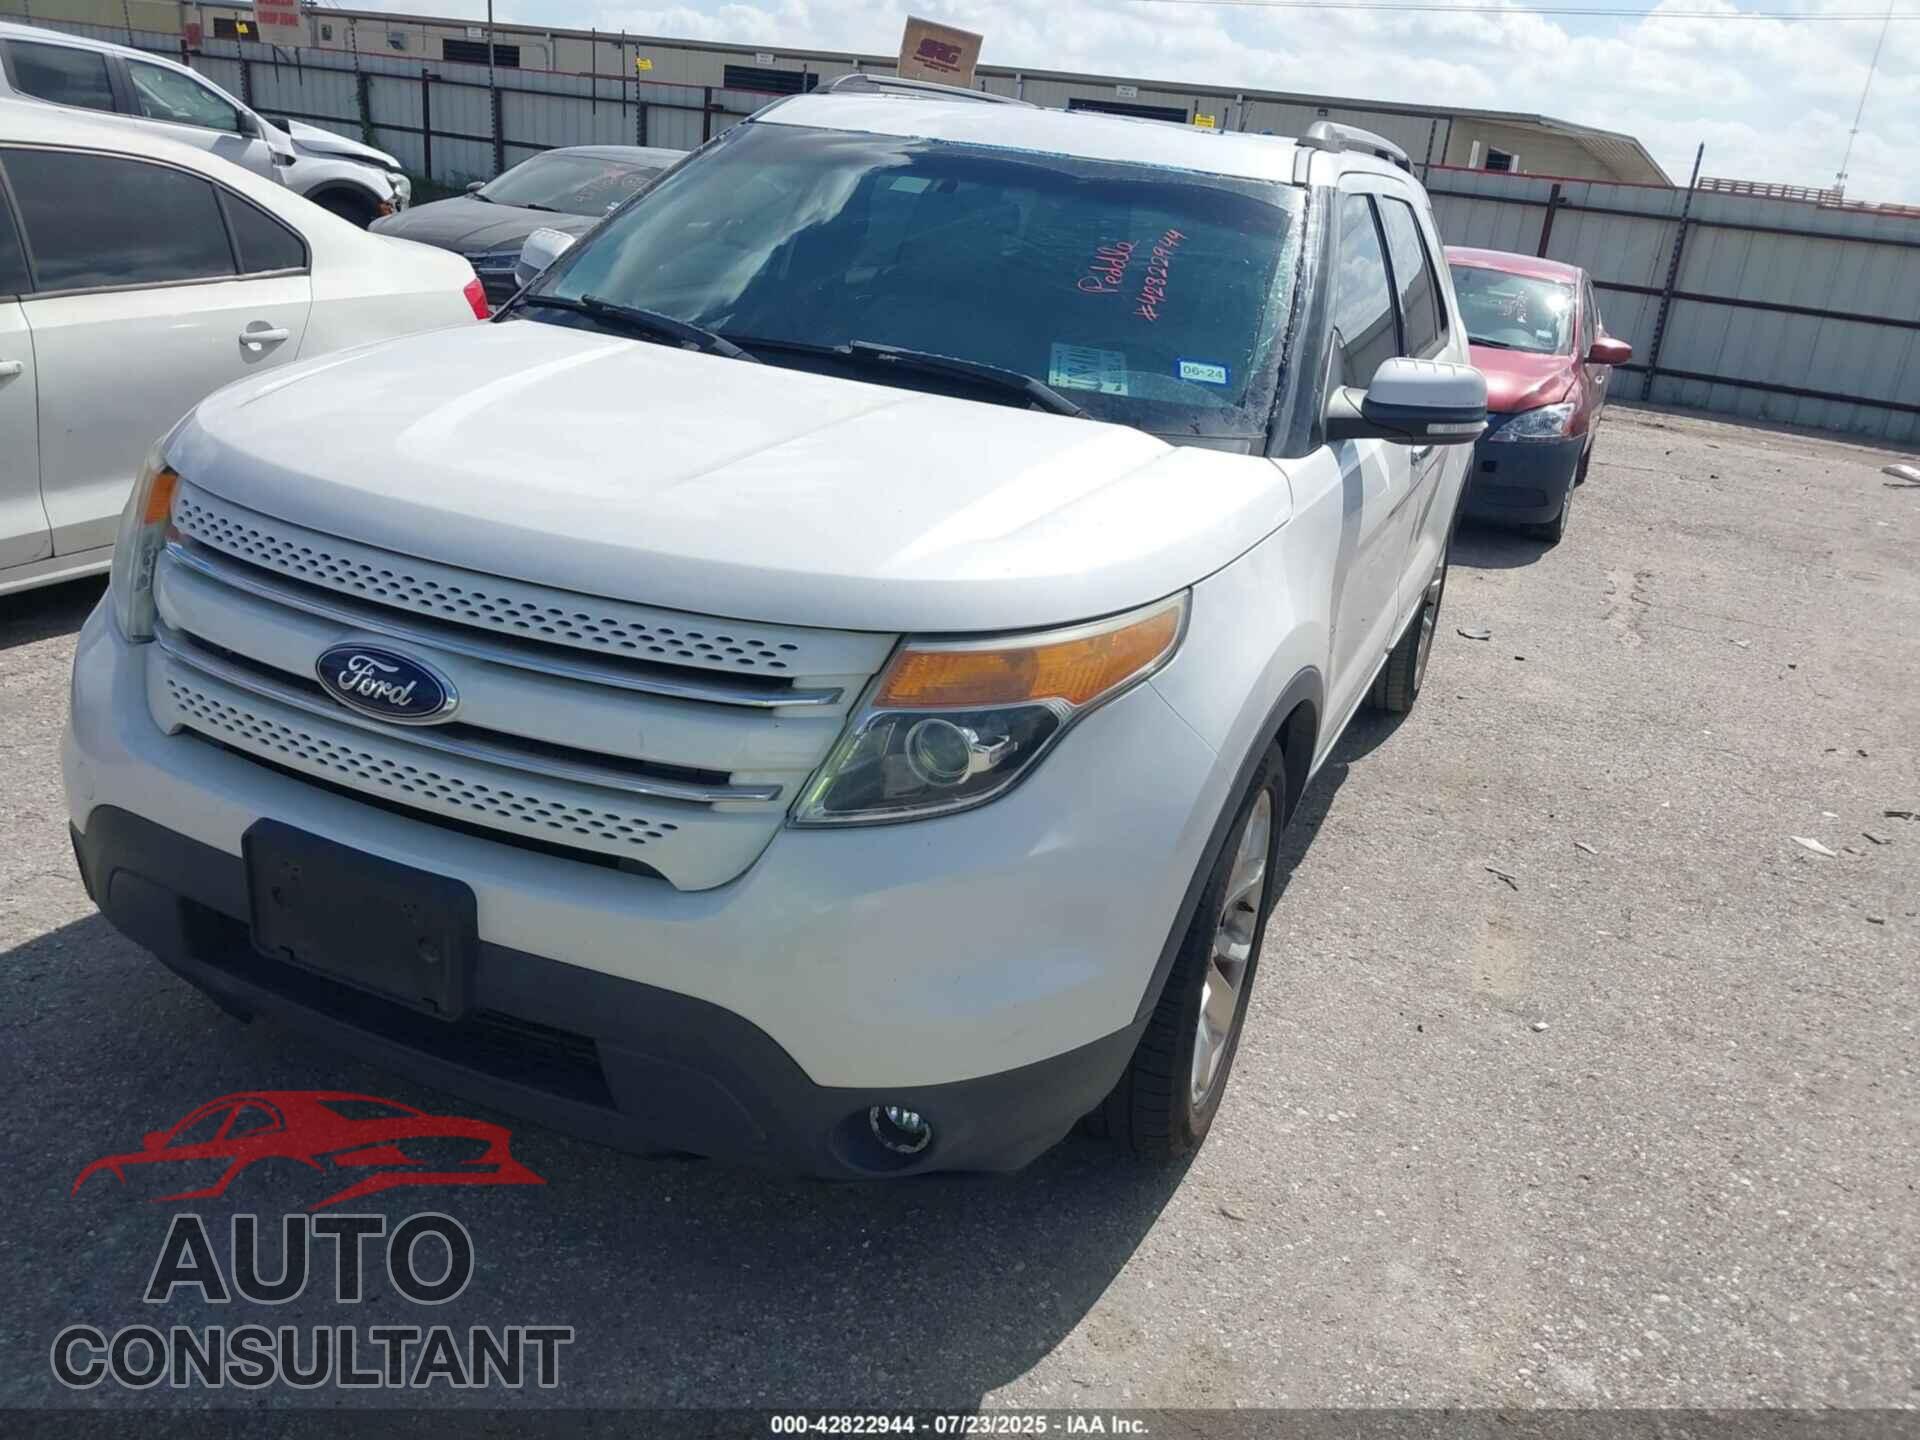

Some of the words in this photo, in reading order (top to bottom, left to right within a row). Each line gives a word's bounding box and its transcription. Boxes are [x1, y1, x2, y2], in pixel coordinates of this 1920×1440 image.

[1134, 228, 1187, 321] #42822944
[1183, 365, 1223, 379] 06-24
[337, 655, 417, 706] Ford
